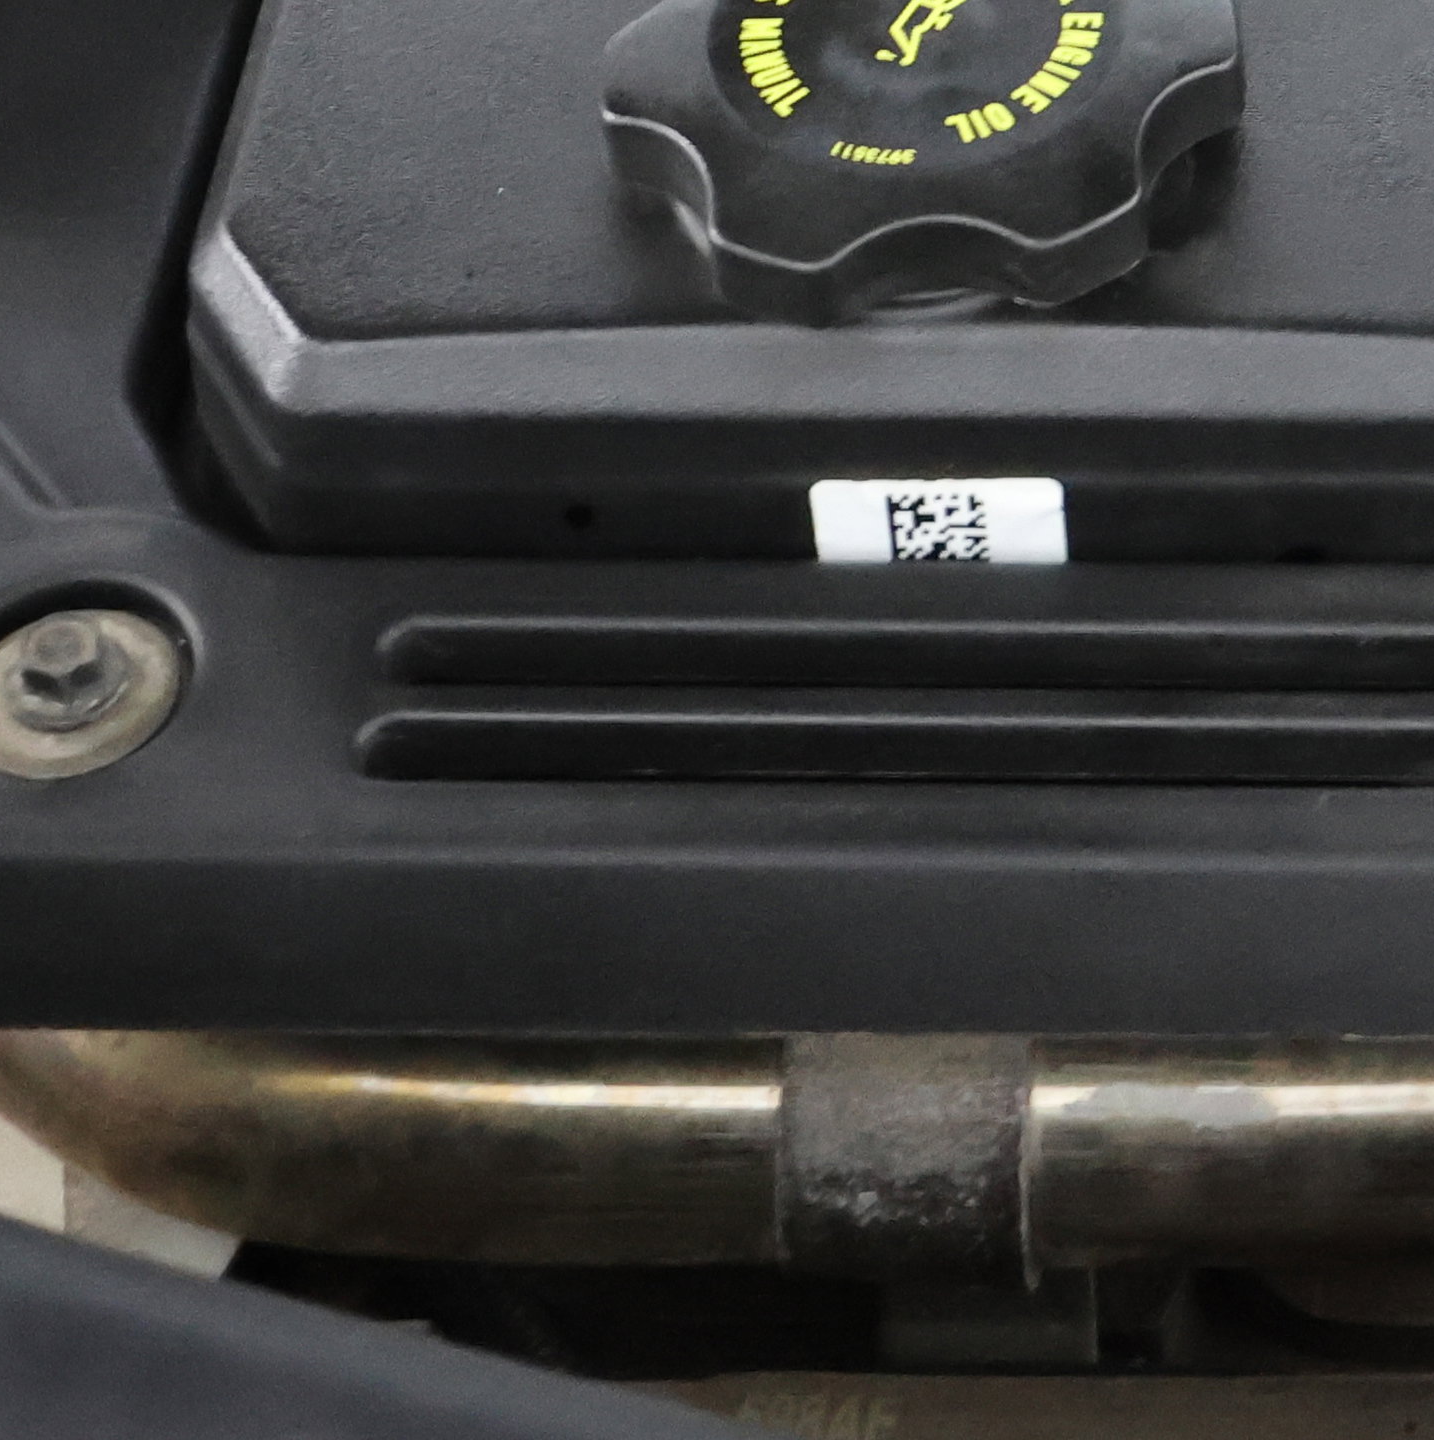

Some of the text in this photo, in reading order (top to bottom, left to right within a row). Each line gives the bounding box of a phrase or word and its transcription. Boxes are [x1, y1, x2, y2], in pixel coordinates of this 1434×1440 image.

[738, 17, 811, 119] MANUAL
[1009, 9, 1106, 116] ENGINE
[944, 102, 1018, 145] OIL
